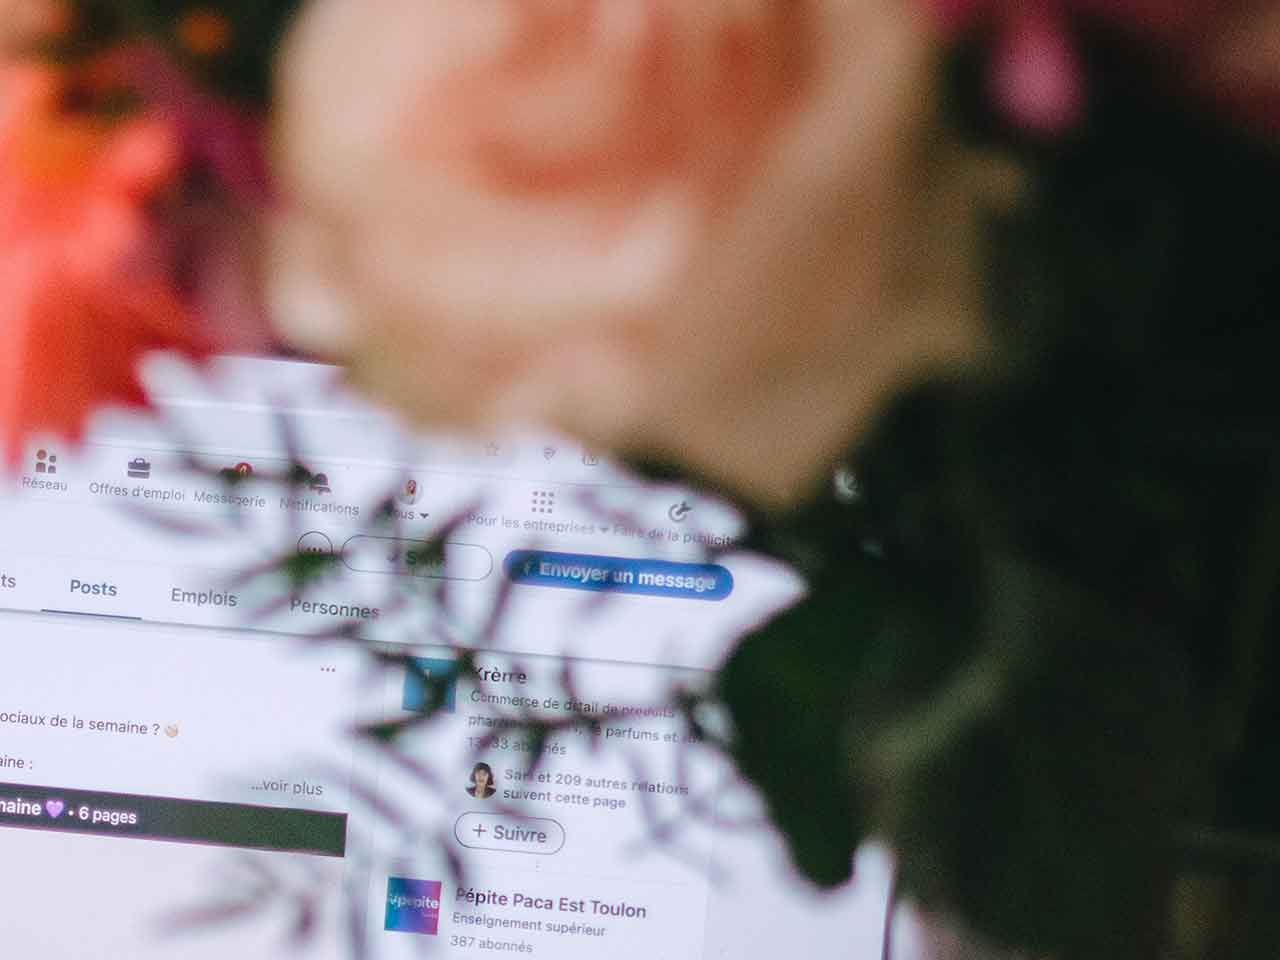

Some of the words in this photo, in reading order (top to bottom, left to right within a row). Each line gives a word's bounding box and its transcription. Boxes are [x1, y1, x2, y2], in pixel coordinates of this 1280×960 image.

[22, 475, 68, 491] Réseau
[89, 482, 128, 498] Offres
[132, 487, 185, 502] d'emploi
[467, 512, 497, 528] Pour
[502, 516, 521, 529] les
[523, 518, 595, 535] entreprises
[669, 529, 679, 541] la
[540, 563, 609, 583] Envoyer
[614, 570, 633, 584] un
[639, 574, 716, 593] message
[70, 579, 117, 597] Posts
[171, 588, 238, 607] Emplois
[289, 599, 379, 619] Personnes
[470, 690, 539, 709] Commerce
[544, 696, 559, 710] de
[50, 715, 68, 728] de
[72, 716, 84, 730] la
[89, 719, 148, 735] semaine
[606, 726, 659, 743] parfums
[293, 781, 323, 796] plus
[538, 772, 551, 784] et
[555, 773, 581, 786] 209
[585, 777, 627, 791] autres
[504, 788, 551, 802] suivent
[555, 792, 588, 805] cette
[593, 797, 626, 810] page
[79, 806, 89, 820] 6
[93, 809, 136, 825] pages
[494, 825, 547, 843] Suivre
[456, 887, 508, 908] Pépite
[513, 894, 554, 910] Paca
[559, 897, 584, 912] Est
[591, 900, 646, 918] Toulon
[453, 912, 542, 932] Enseignement
[546, 919, 606, 938] supérieur
[450, 935, 475, 948] 387
[479, 938, 533, 953] abonnés
